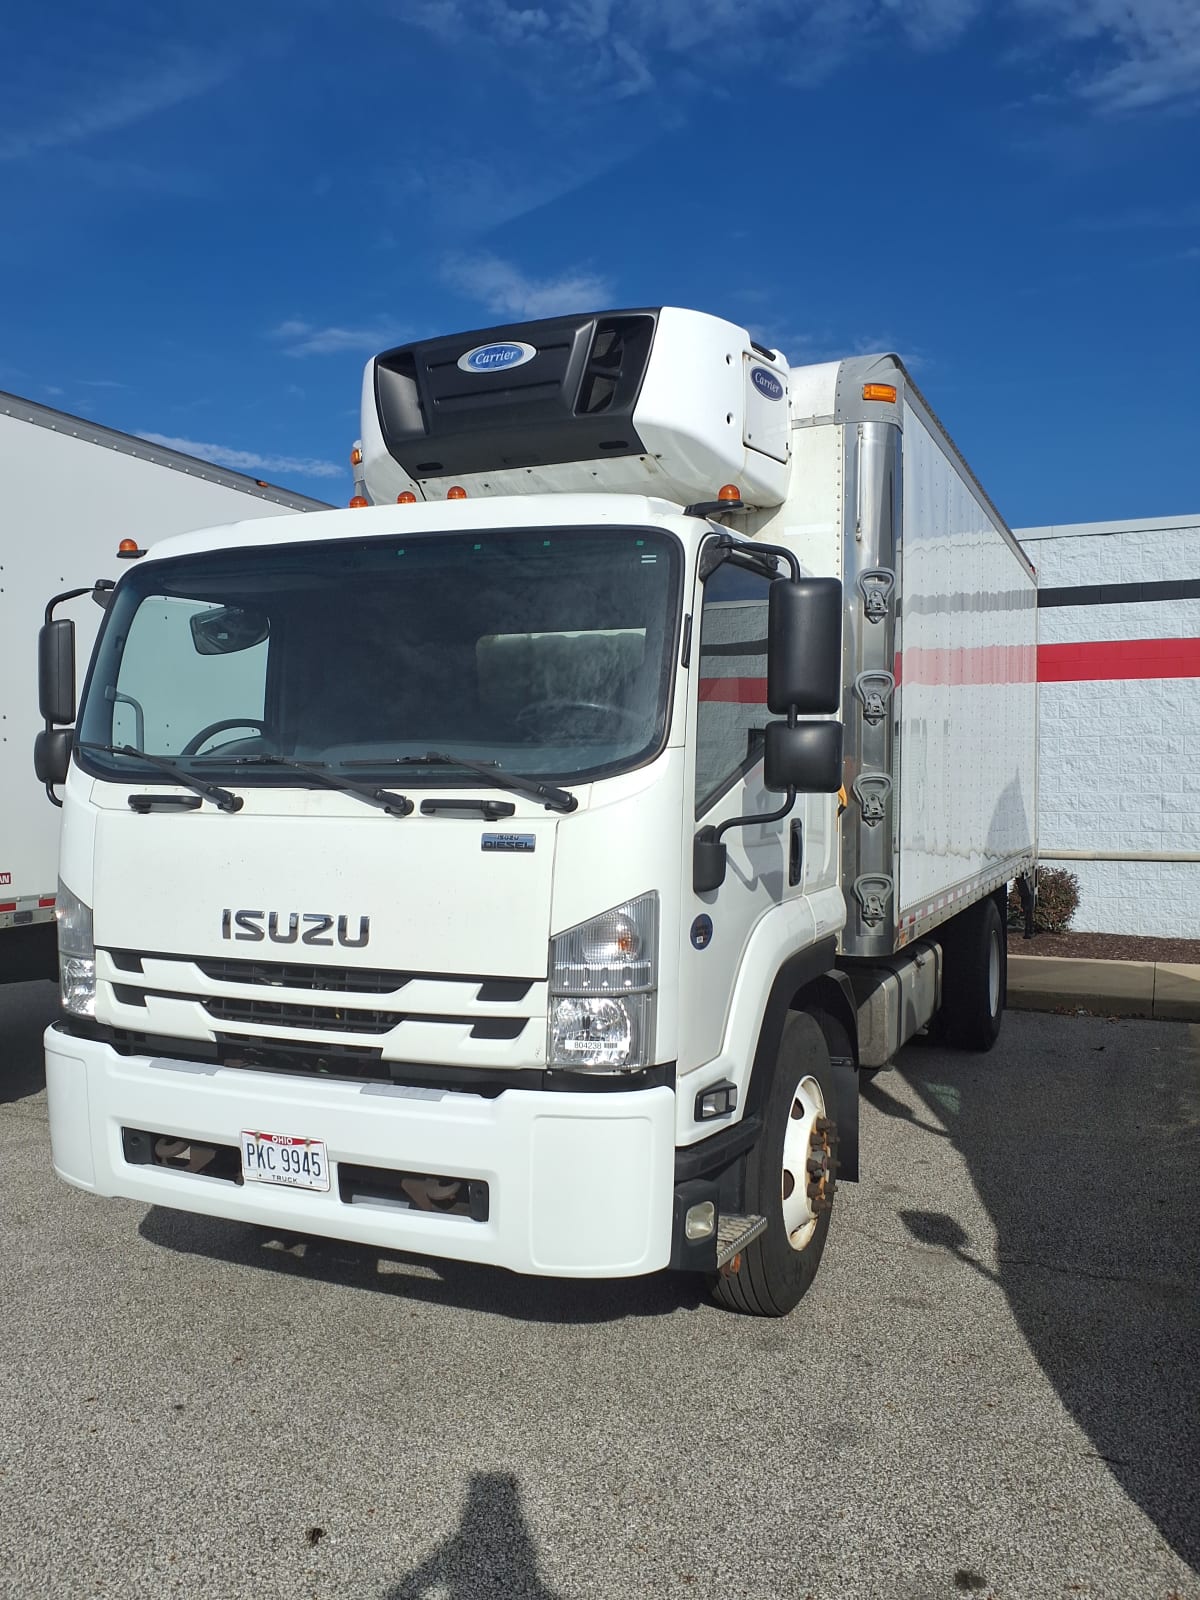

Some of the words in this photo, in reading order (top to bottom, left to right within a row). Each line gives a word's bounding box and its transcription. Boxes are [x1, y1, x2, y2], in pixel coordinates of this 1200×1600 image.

[475, 350, 517, 365] Carrier
[755, 372, 780, 393] Carrier
[483, 840, 532, 849] DIESEL
[222, 908, 370, 948] ISUZU
[574, 1042, 602, 1050] 804238
[271, 1135, 293, 1145] OHIO
[246, 1142, 276, 1170] PKC
[281, 1148, 321, 1177] 9945
[271, 1174, 298, 1183] TRUCK
